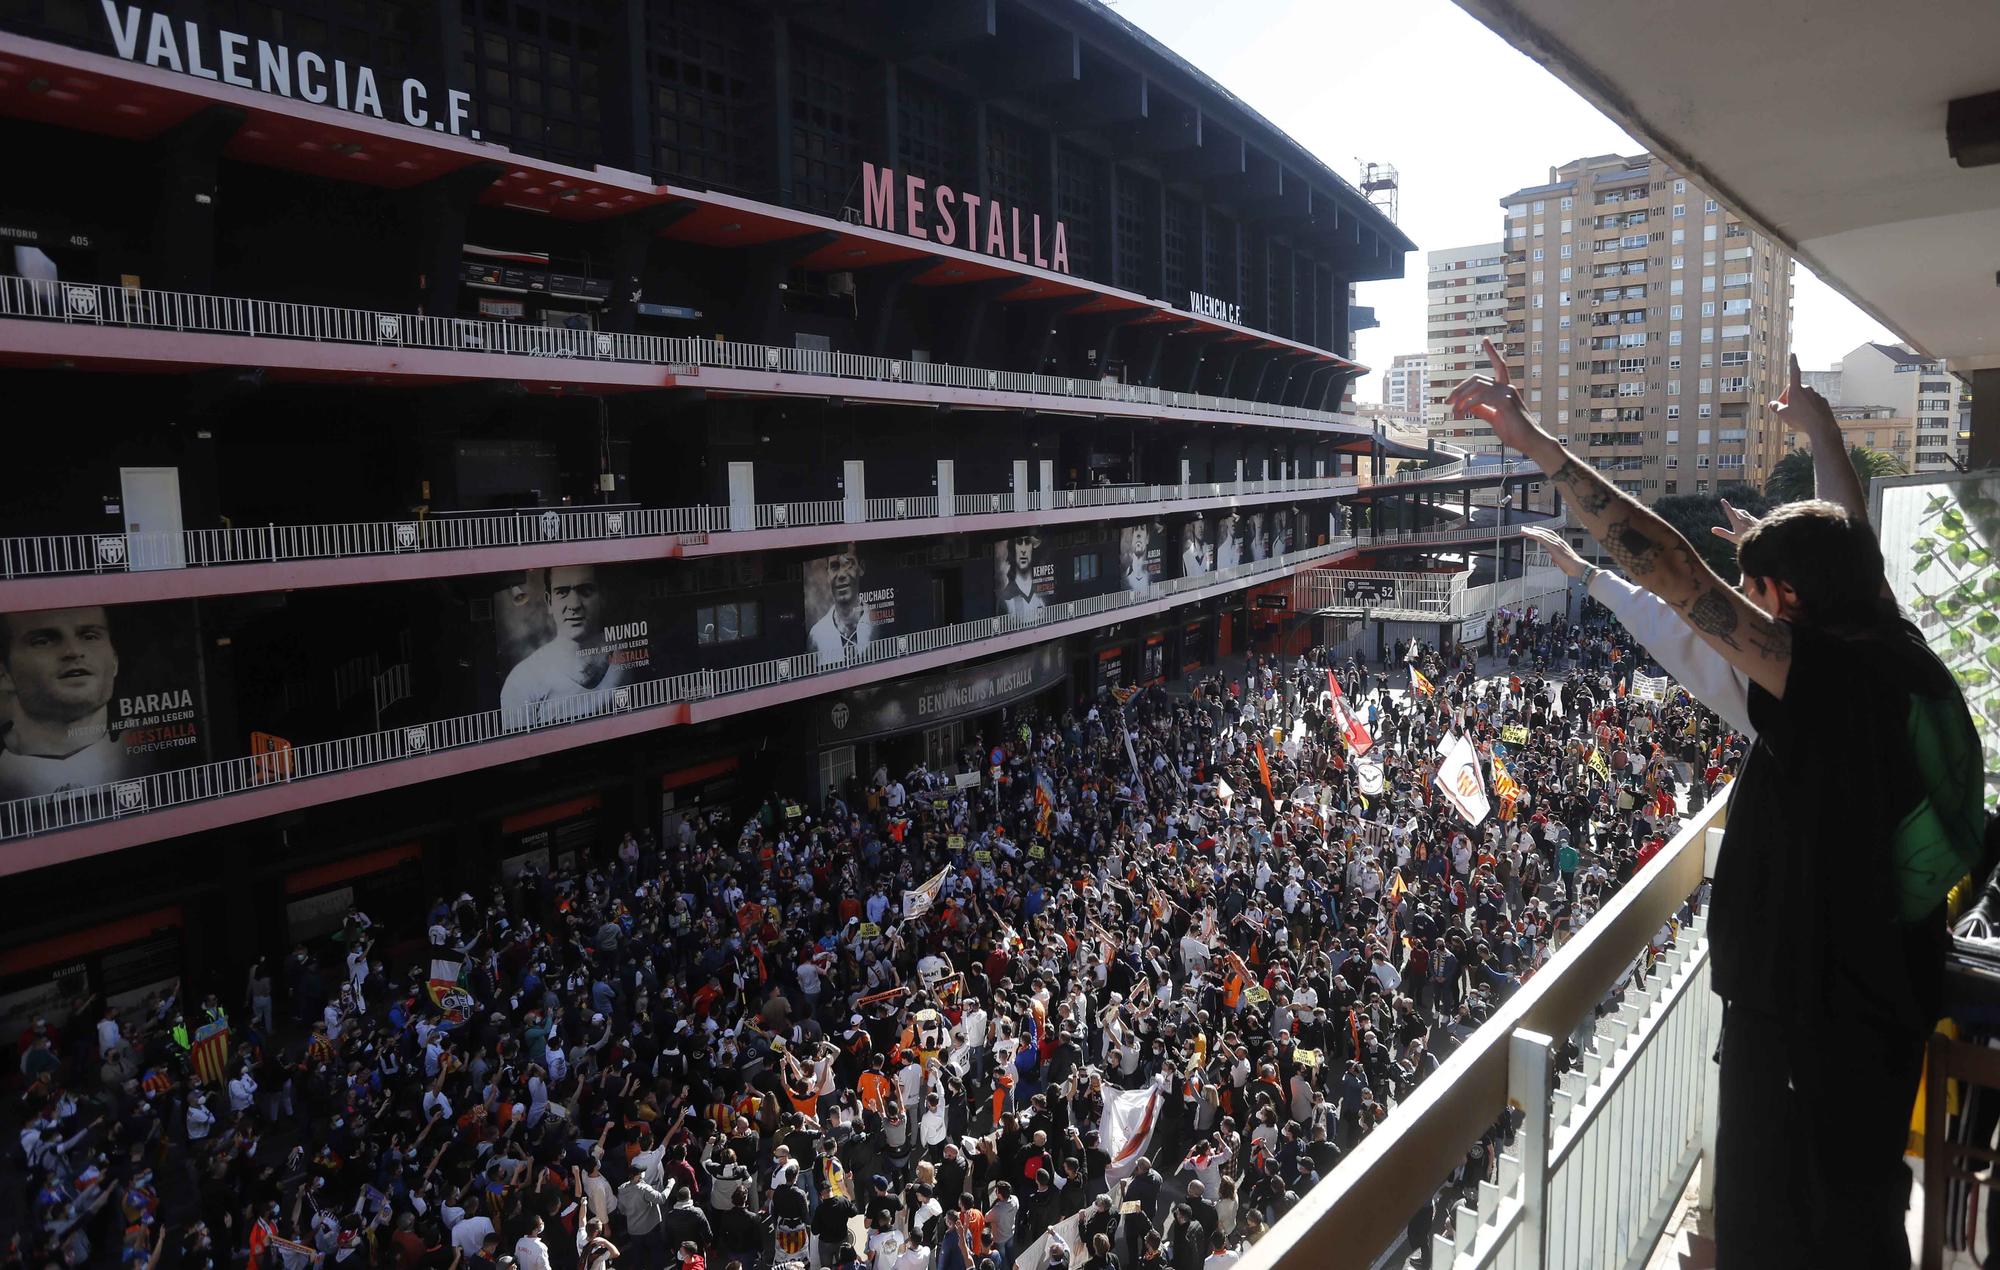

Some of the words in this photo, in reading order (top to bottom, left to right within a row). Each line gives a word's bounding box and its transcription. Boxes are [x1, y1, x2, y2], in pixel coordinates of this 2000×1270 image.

[103, 0, 383, 118] VALENCIA
[402, 77, 481, 140] C.F.
[862, 161, 1069, 275] MESTALLA
[70, 235, 89, 247] 405
[1190, 290, 1227, 322] VALENCIA
[1228, 303, 1242, 326] C.F.
[1033, 564, 1055, 578] KEMPES
[1381, 586, 1393, 598] 52
[604, 620, 648, 643] MUNDO
[629, 638, 649, 649] LEGEND
[918, 680, 989, 716] BENVINGUTS
[989, 680, 996, 699] A
[996, 667, 1032, 696] MESTALLA
[119, 689, 194, 717] BARAJA
[112, 718, 141, 732] HEART
[142, 715, 160, 727] AND
[162, 710, 195, 724] LEGEND
[126, 720, 198, 745] MESTALLA
[1503, 734, 1525, 743] HOME
[127, 737, 197, 756] FOREVERTOUR
